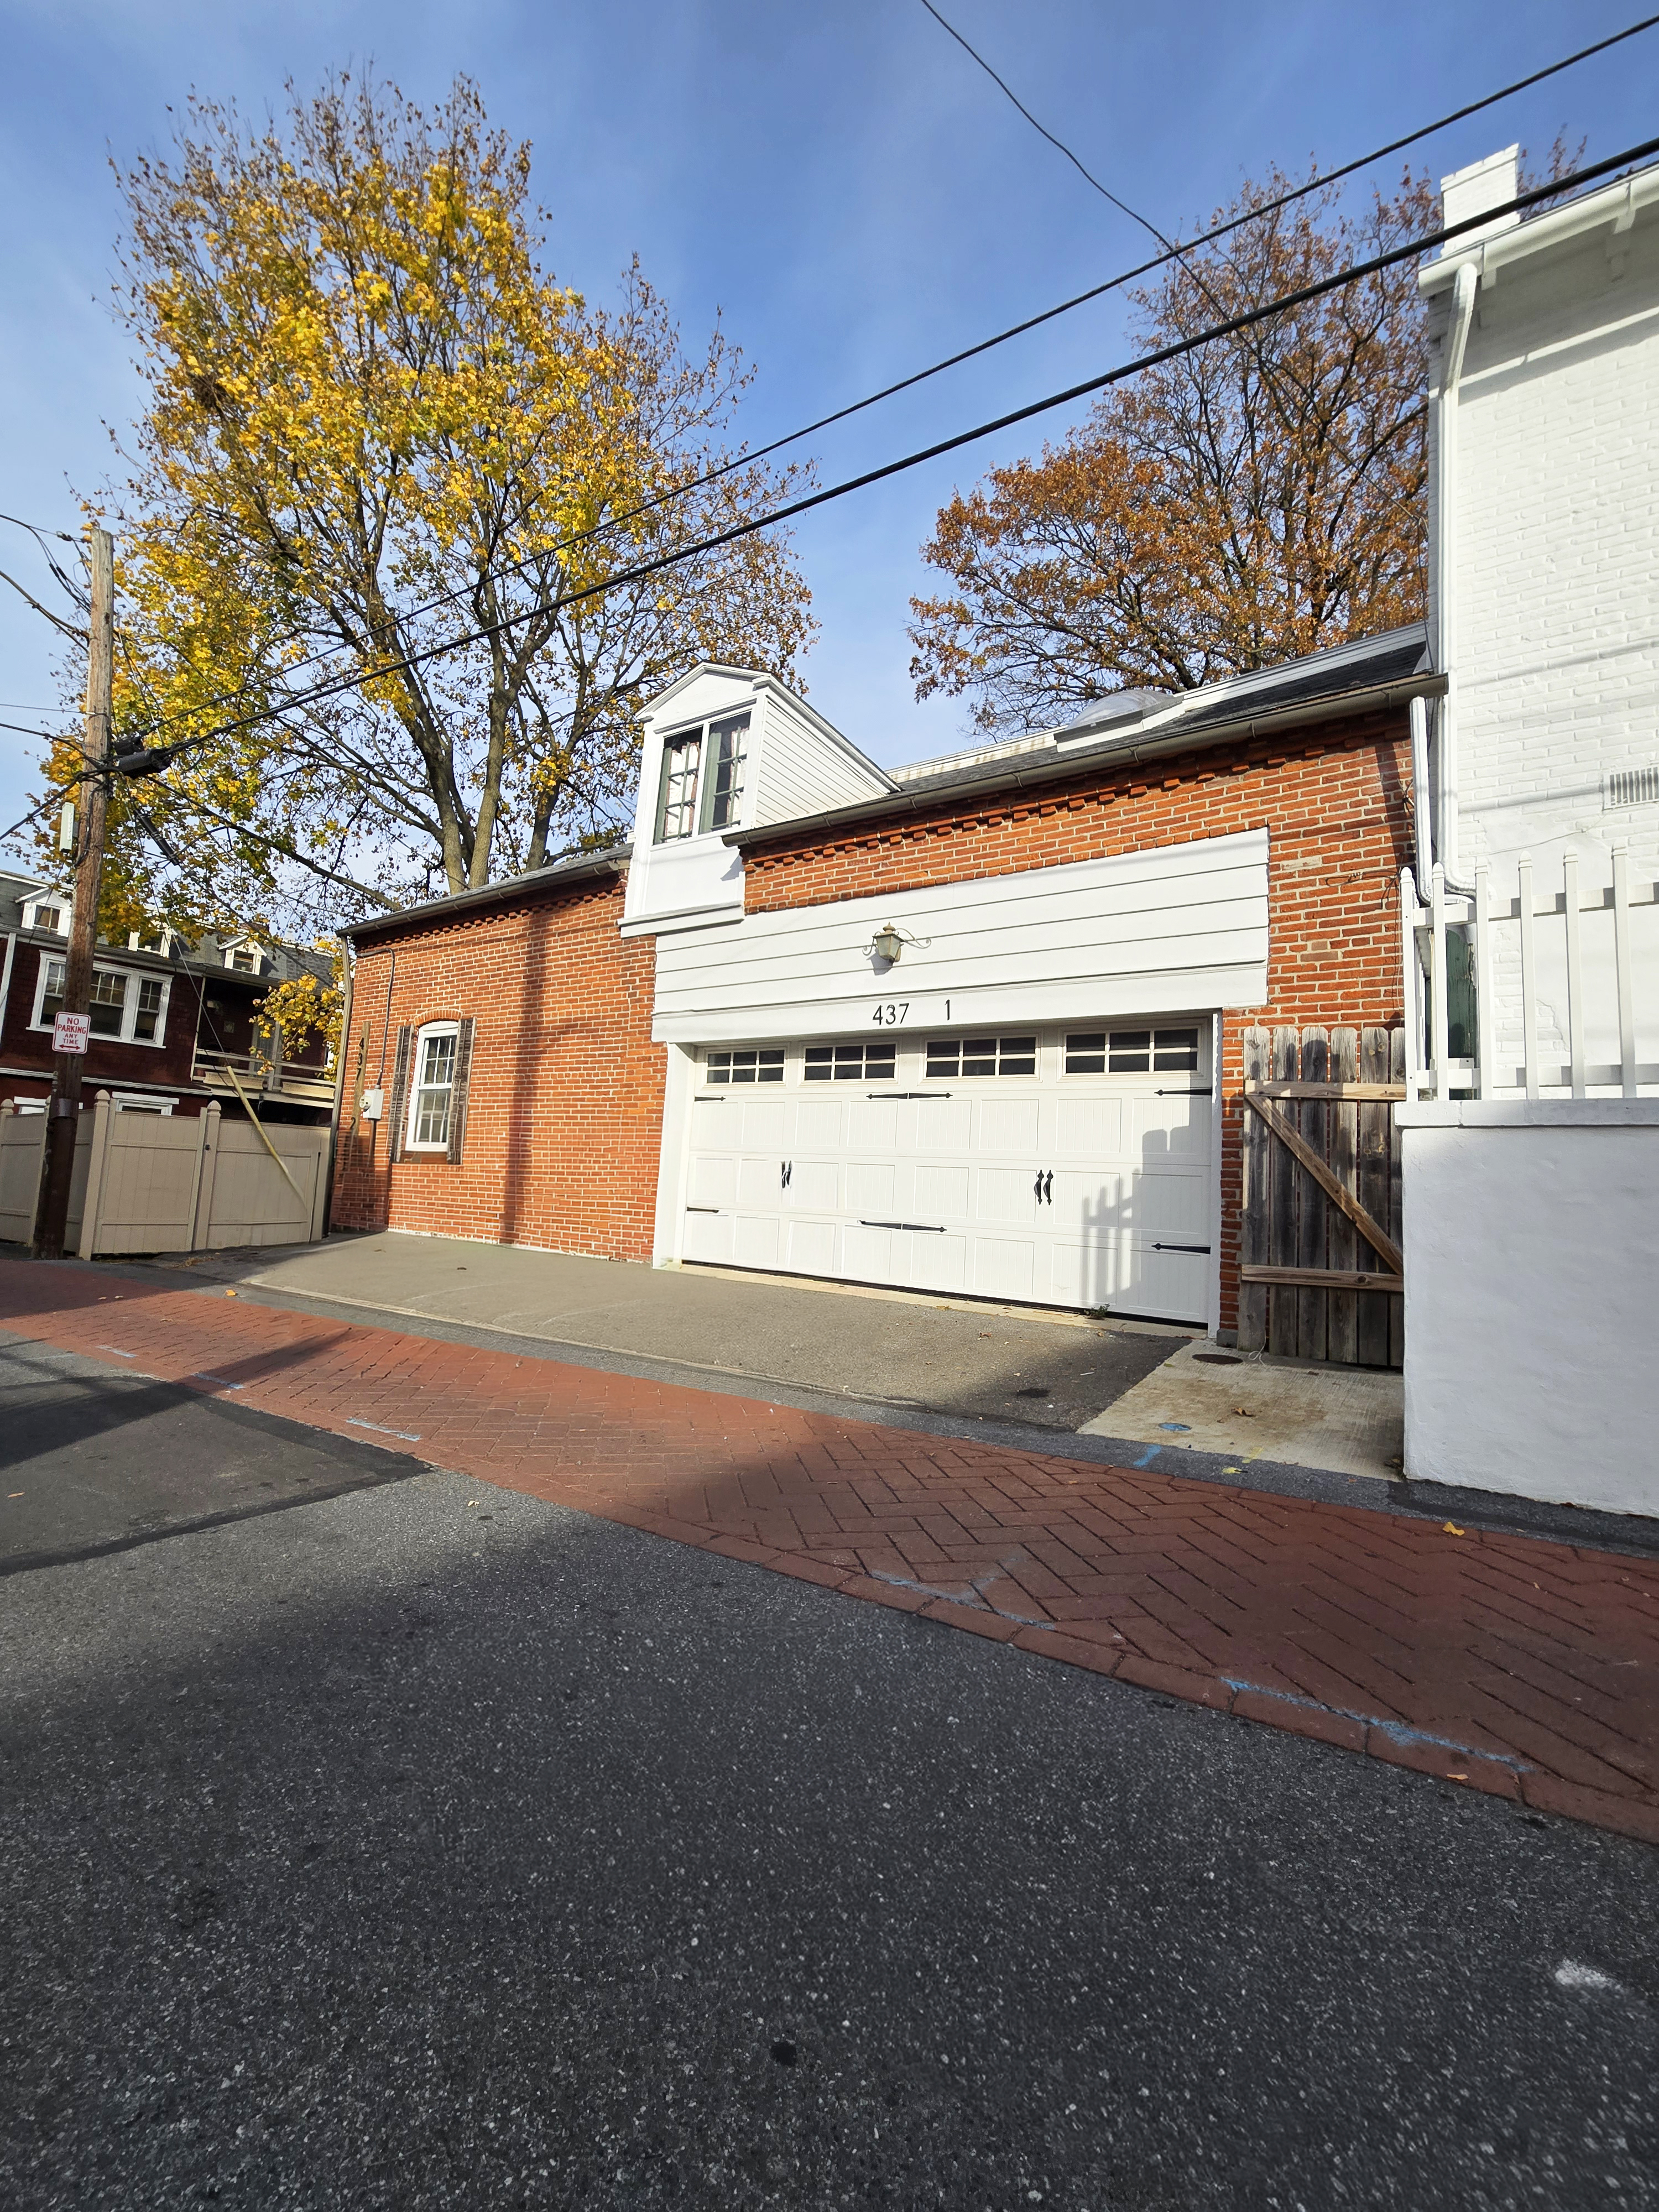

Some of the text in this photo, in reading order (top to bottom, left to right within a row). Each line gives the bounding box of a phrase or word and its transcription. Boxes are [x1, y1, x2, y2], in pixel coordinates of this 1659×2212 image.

[872, 999, 950, 1025] 437 1
[58, 1024, 86, 1034] PARKING
